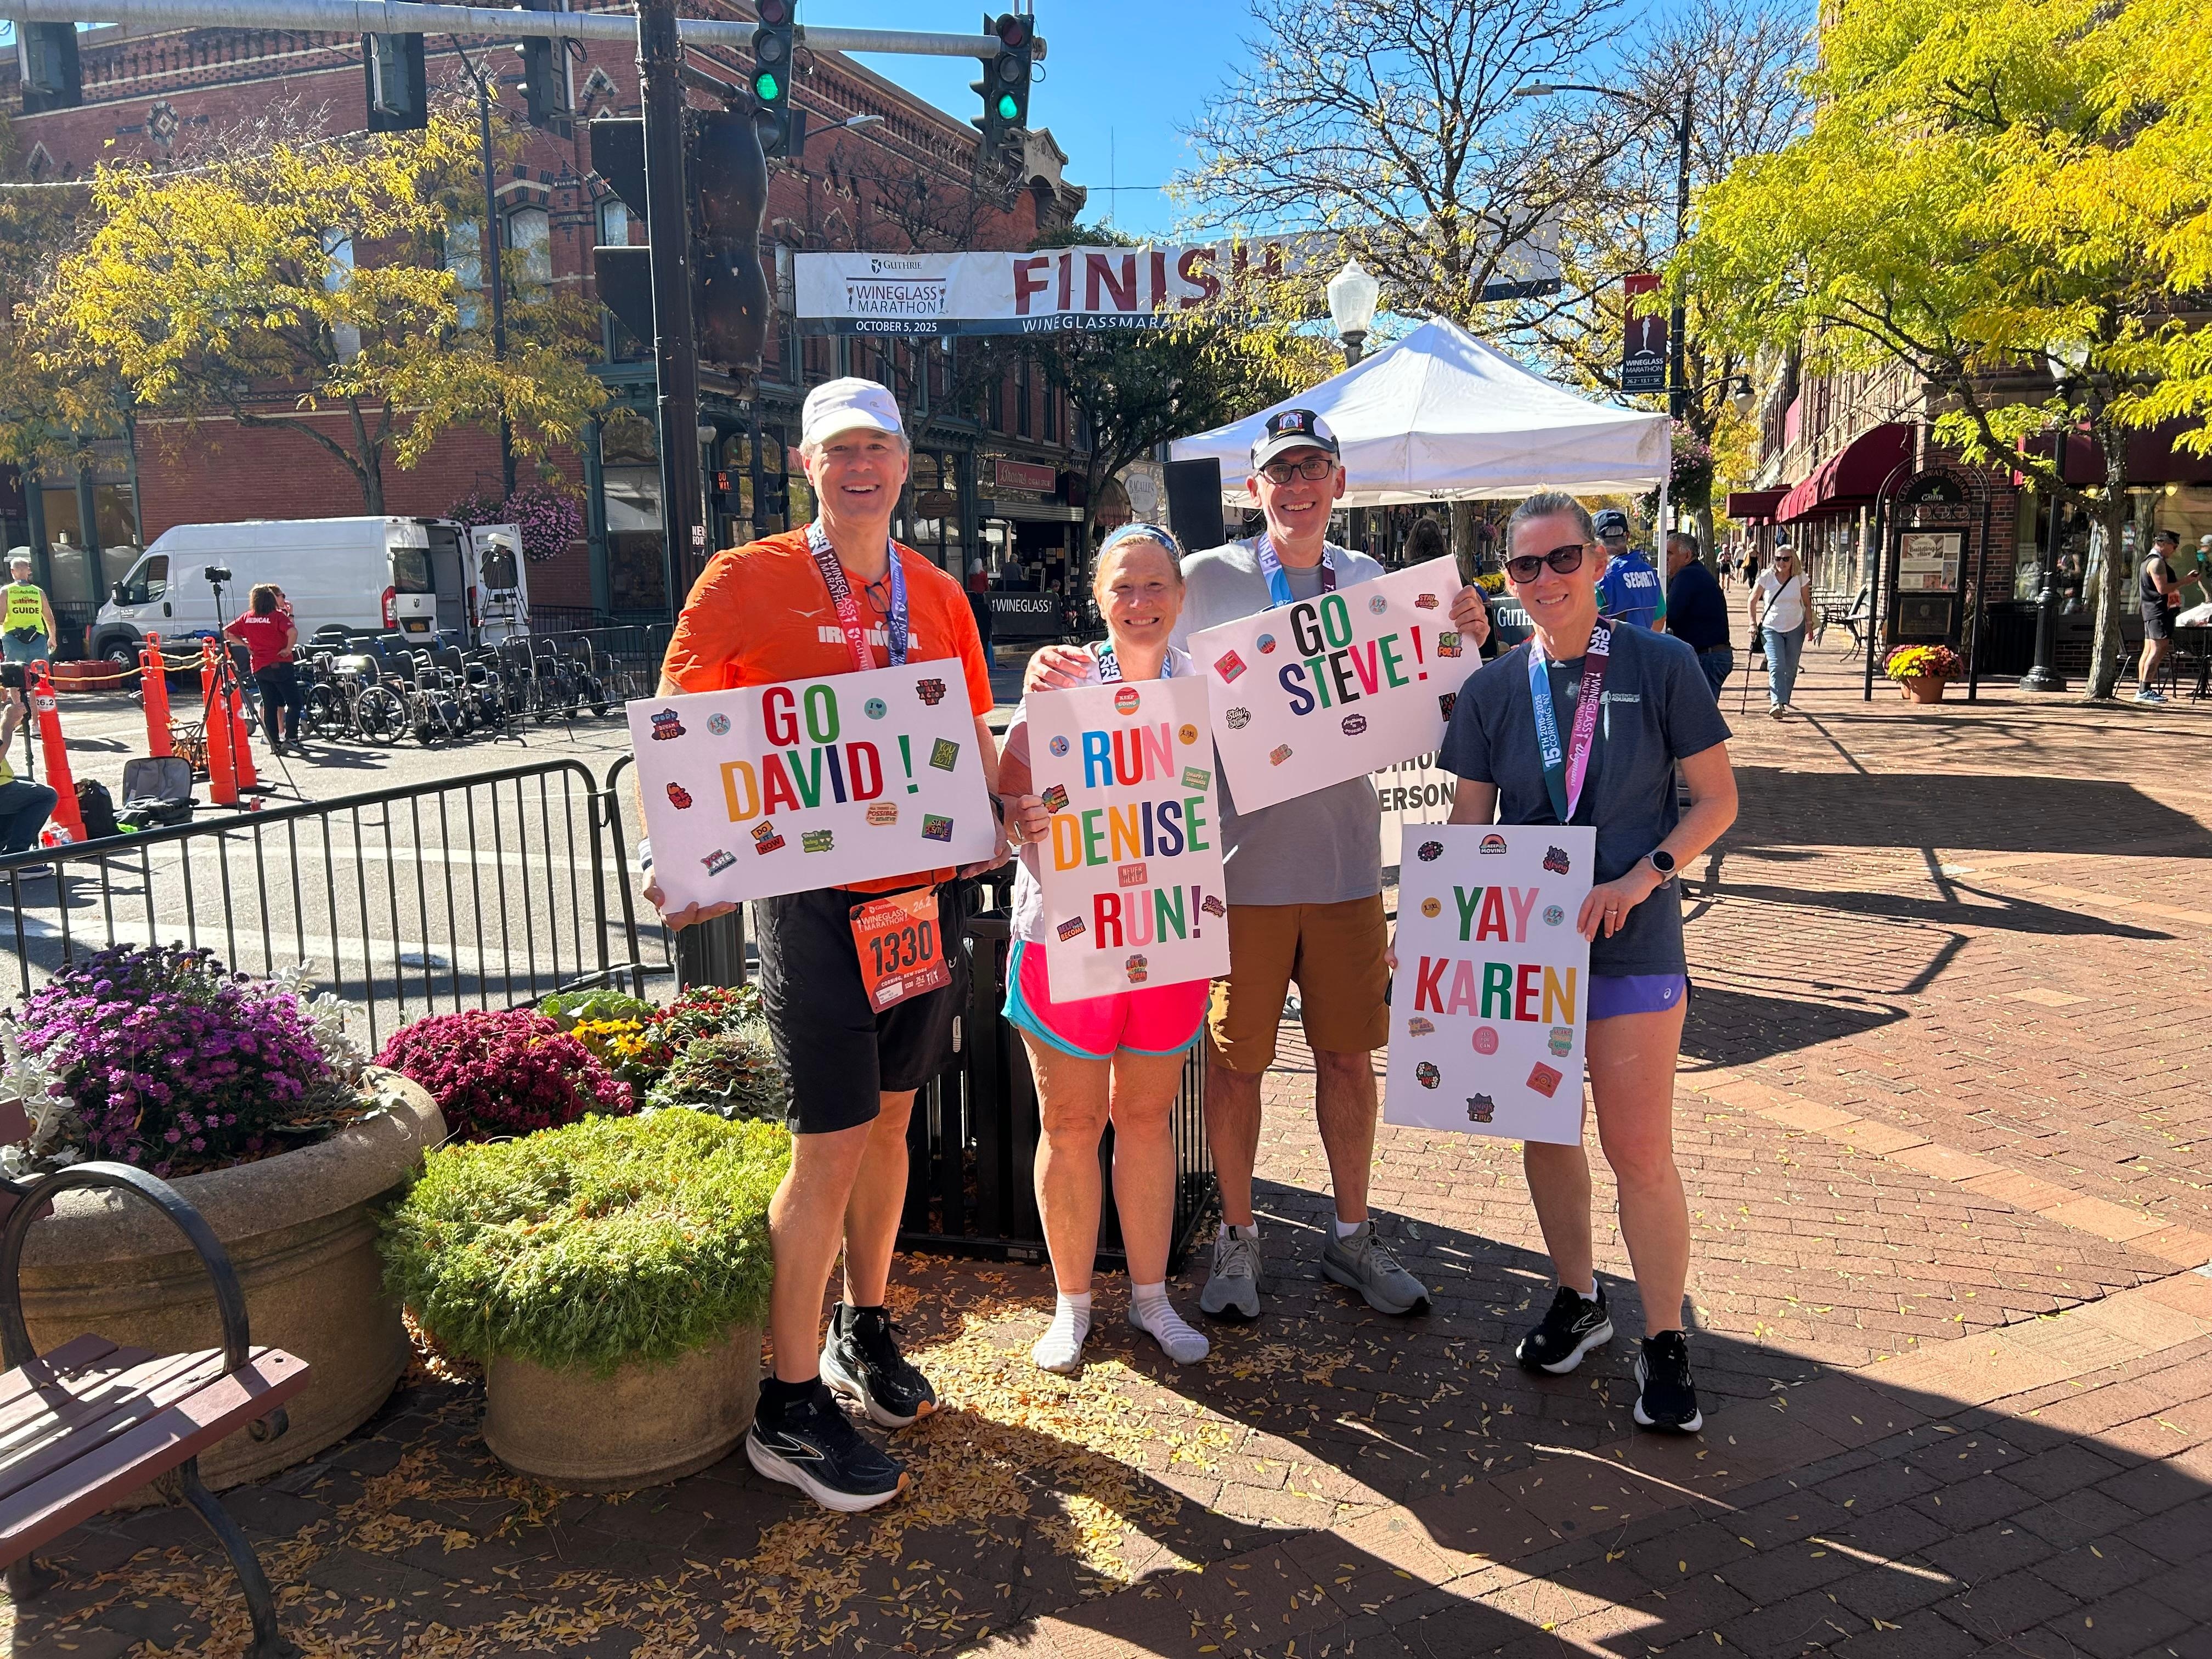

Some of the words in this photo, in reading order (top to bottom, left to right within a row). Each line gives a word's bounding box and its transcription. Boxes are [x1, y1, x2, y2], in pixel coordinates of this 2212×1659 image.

[883, 261, 922, 270] GUTHRIE
[856, 286, 937, 300] WINEGLASS
[858, 301, 936, 313] MARATHON
[856, 321, 902, 331] OCTOBER
[904, 321, 911, 332] 5,
[913, 321, 937, 332] 2025
[1626, 358, 1663, 366] WINEGLASS
[719, 482, 732, 490] WAL
[1899, 469, 1944, 501] CENTERWAY
[1945, 471, 1971, 501] SQUARE
[820, 563, 848, 620] MARATHON
[826, 556, 856, 618] WINEGLASS
[996, 599, 1049, 613] WINEGLASS
[1497, 606, 1533, 628] GUTH
[1290, 595, 1352, 657] GO
[1592, 627, 1611, 641] 20
[1441, 633, 1460, 646] GO
[1438, 646, 1453, 657] FOR
[1453, 646, 1462, 657] IT
[1589, 640, 1610, 656] 25
[1099, 653, 1117, 669] 20
[1101, 665, 1121, 680] 25
[1581, 678, 1590, 694] HALF
[1542, 693, 1549, 706] NY
[1582, 677, 1602, 736] WINEGLASS
[652, 712, 676, 722] WORK
[762, 684, 840, 747] GO
[1574, 693, 1586, 735] MARATHON
[1543, 705, 1558, 747] CORNING,
[940, 741, 956, 753] YOU
[1082, 723, 1175, 788] RUN
[1569, 742, 1585, 786] Wegmans
[1379, 782, 1454, 812] ERSON
[756, 826, 768, 836] DO
[1051, 795, 1210, 871] DENISE
[760, 837, 781, 852] NOW
[712, 853, 732, 868] ARE
[913, 895, 932, 913] 26.2
[861, 909, 904, 926] WINEGLASS
[1093, 885, 1201, 949] RUN!
[1453, 885, 1540, 943] YAY
[864, 915, 904, 932] MARATHON
[1060, 926, 1085, 941] BECOME
[869, 920, 934, 977] 1330
[1414, 956, 1577, 1025] KAREN
[800, 1444, 818, 1457] BROOKS
